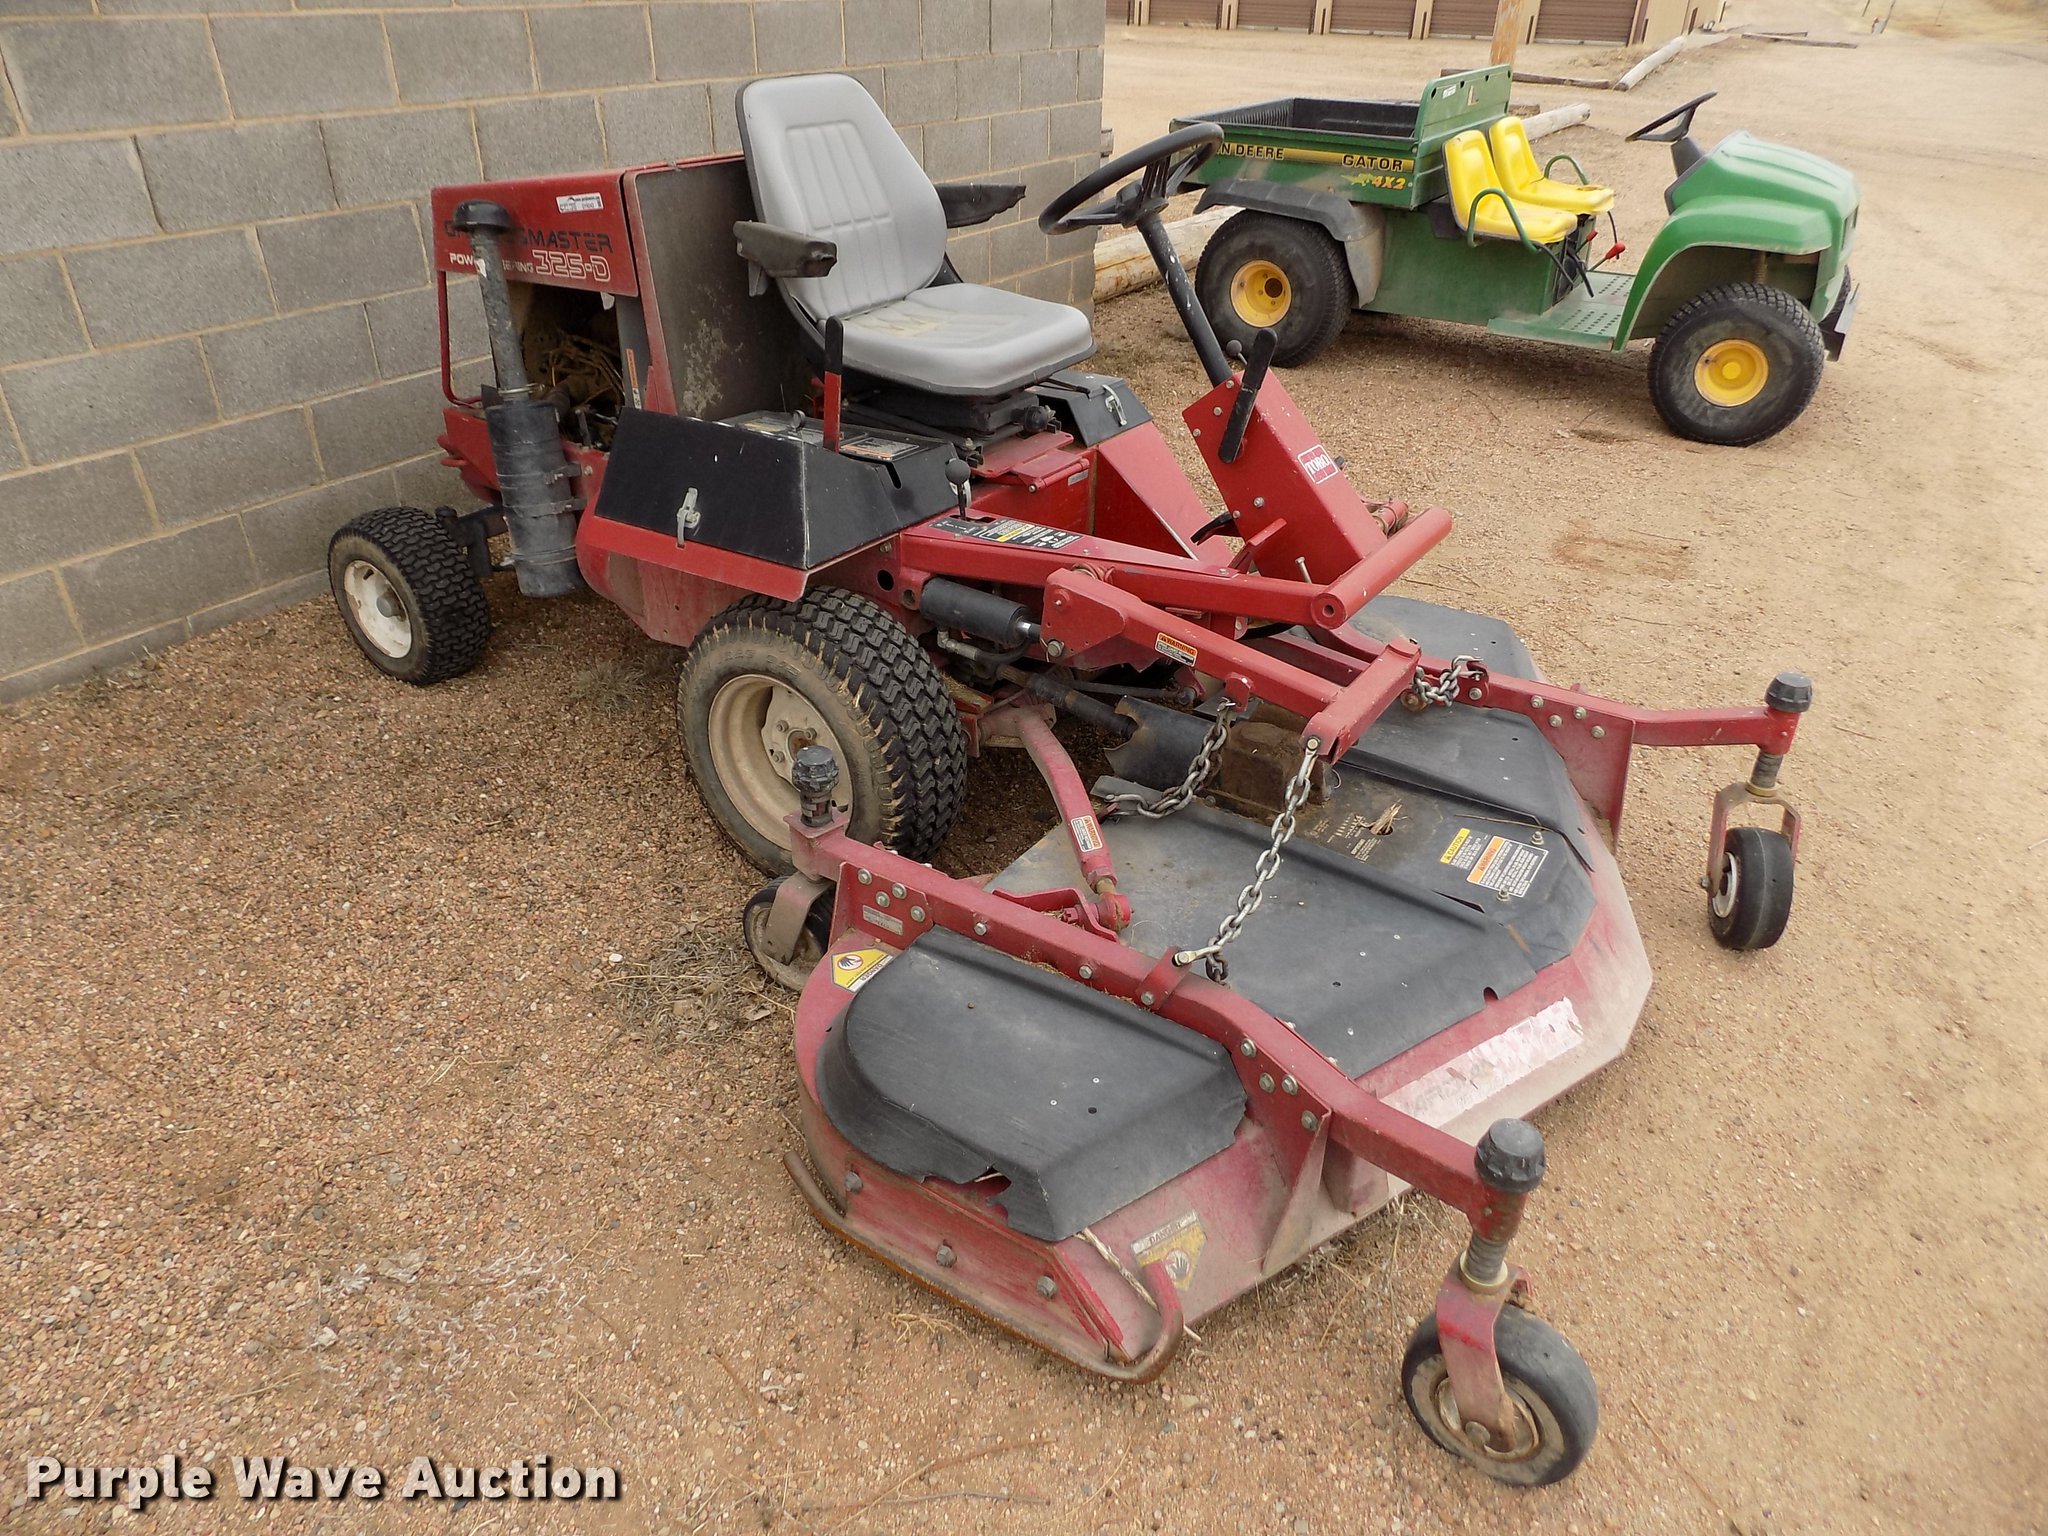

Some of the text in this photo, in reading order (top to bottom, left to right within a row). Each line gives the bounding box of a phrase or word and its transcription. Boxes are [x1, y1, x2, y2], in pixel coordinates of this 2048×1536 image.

[1235, 143, 1284, 160] DEERE
[1342, 154, 1403, 172] GATOR
[1371, 175, 1406, 190] 4X2
[531, 249, 611, 282] 325-D
[1304, 453, 1331, 475] TORO
[1449, 835, 1465, 857] CAUTION
